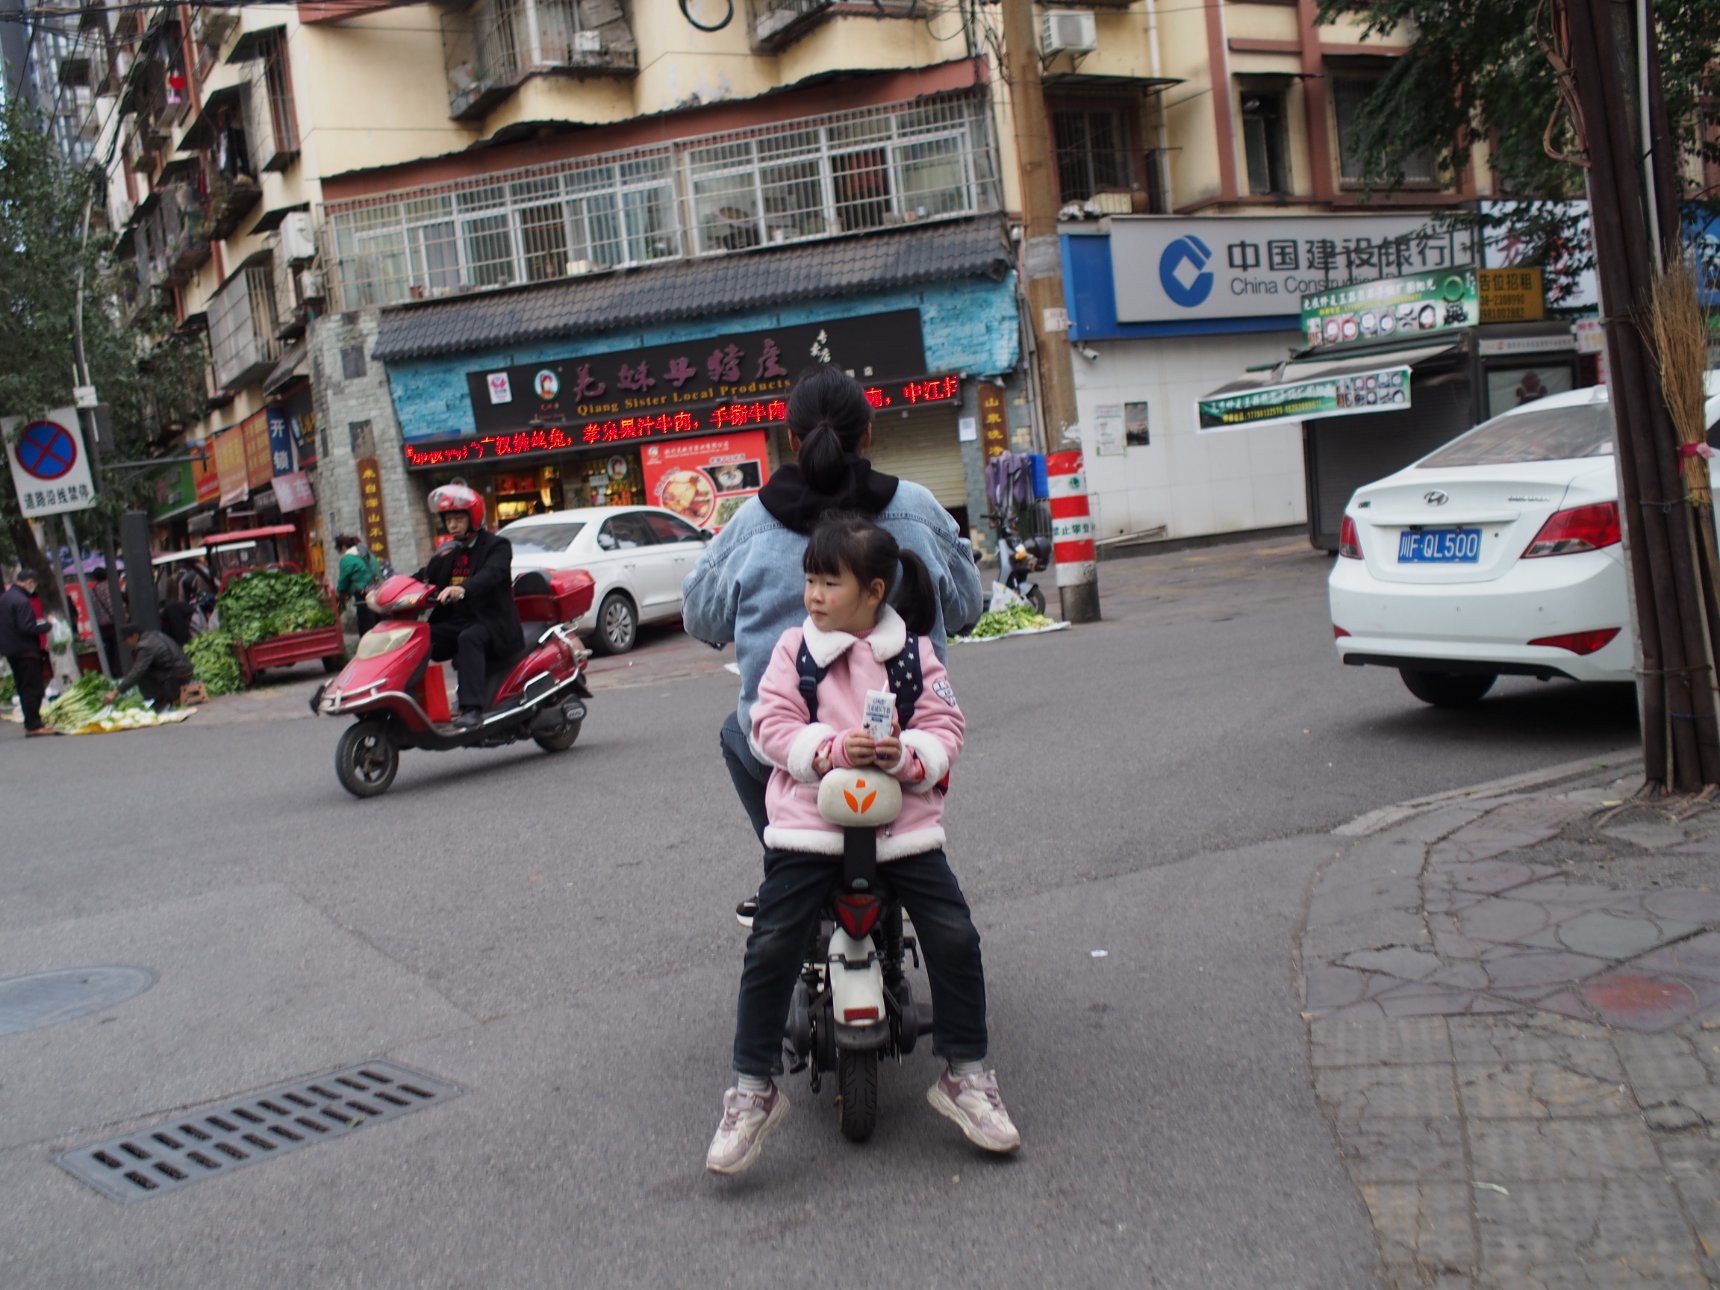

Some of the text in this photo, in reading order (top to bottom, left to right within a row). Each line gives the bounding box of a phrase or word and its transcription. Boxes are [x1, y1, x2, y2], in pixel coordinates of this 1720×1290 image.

[1228, 236, 1447, 272] 中国建设银行
[1231, 277, 1278, 296] China
[577, 379, 792, 416] Qiang Sister Local Products
[270, 418, 290, 470] 开锁
